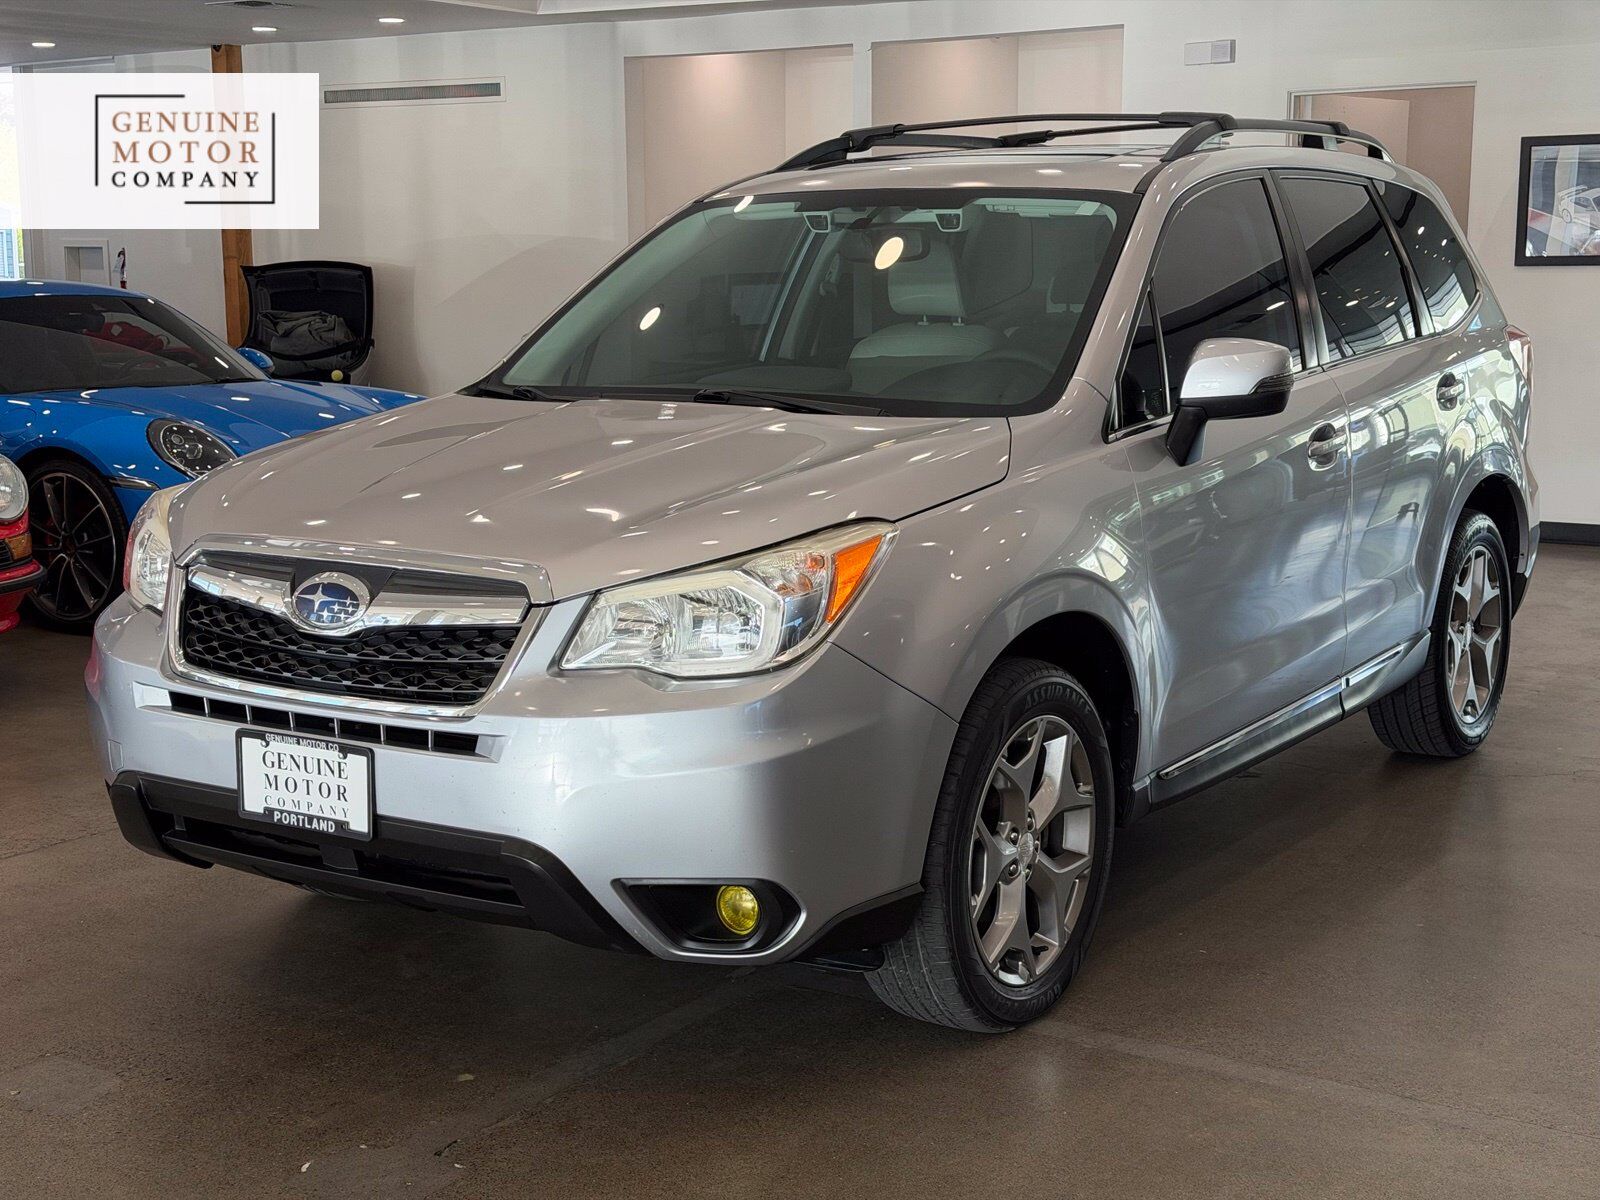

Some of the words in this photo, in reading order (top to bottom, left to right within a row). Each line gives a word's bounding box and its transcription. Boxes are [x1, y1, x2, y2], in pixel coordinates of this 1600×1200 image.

[265, 733, 298, 746] GENUINE
[299, 738, 327, 751] MOTOR
[262, 750, 349, 780] GENUINE
[264, 773, 348, 802] MOTOR
[264, 794, 349, 819] COMPANY
[273, 811, 336, 833] PORTLAND
